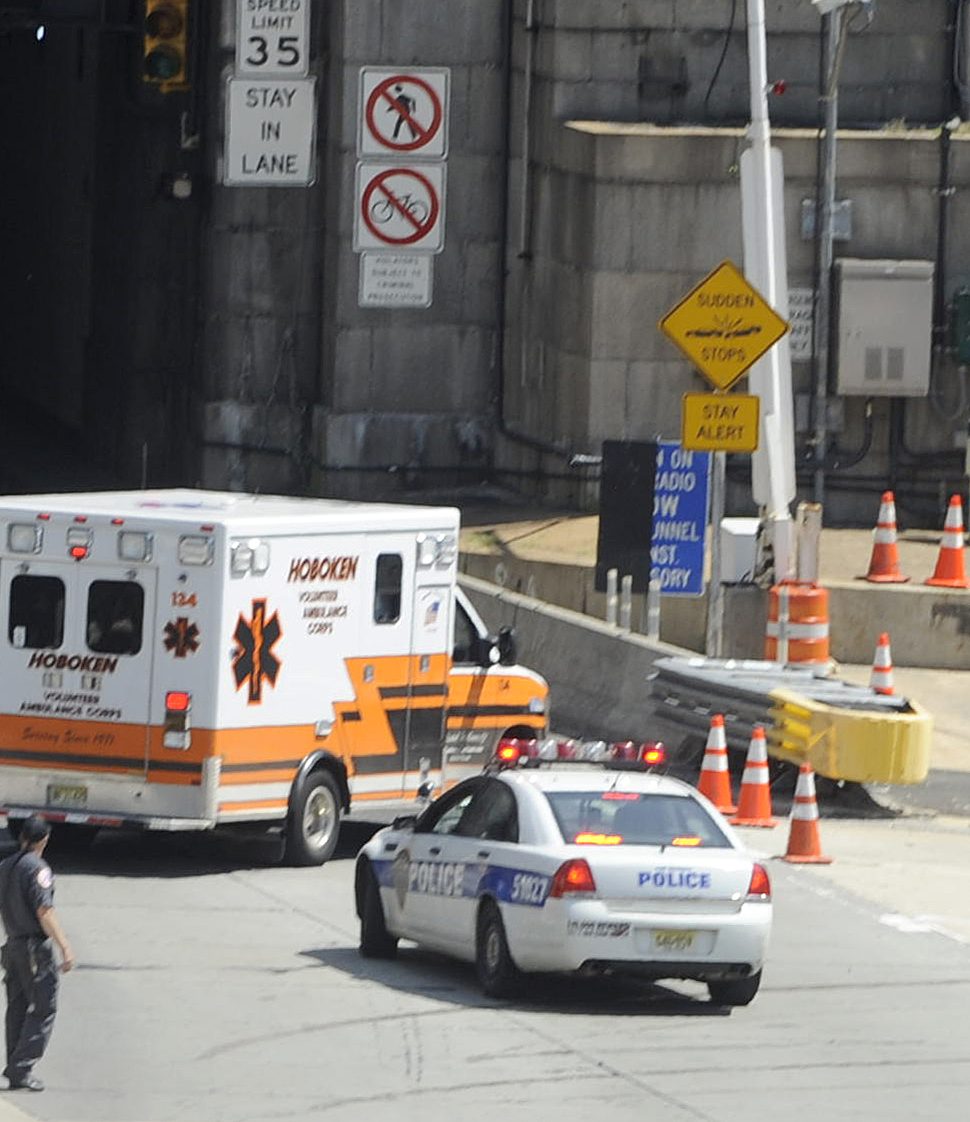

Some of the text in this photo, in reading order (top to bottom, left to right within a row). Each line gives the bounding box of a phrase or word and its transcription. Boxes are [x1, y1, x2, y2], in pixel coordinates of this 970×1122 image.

[251, 16, 294, 30] LIMIT
[246, 36, 300, 66] 35
[246, 87, 297, 109] STAY
[261, 121, 281, 142] IN
[241, 153, 299, 174] LANE
[697, 293, 755, 308] SUDDEN
[701, 347, 746, 362] STOPS
[703, 405, 739, 419] STAY
[696, 426, 745, 440] ALERT
[670, 449, 693, 469] ON
[287, 555, 359, 583] HOBOKEN
[303, 605, 348, 619] AMBULANCE
[307, 622, 333, 635] CORPS
[28, 652, 118, 673] HOBOKEN
[408, 862, 464, 896] POLICE
[638, 872, 711, 888] POLICE
